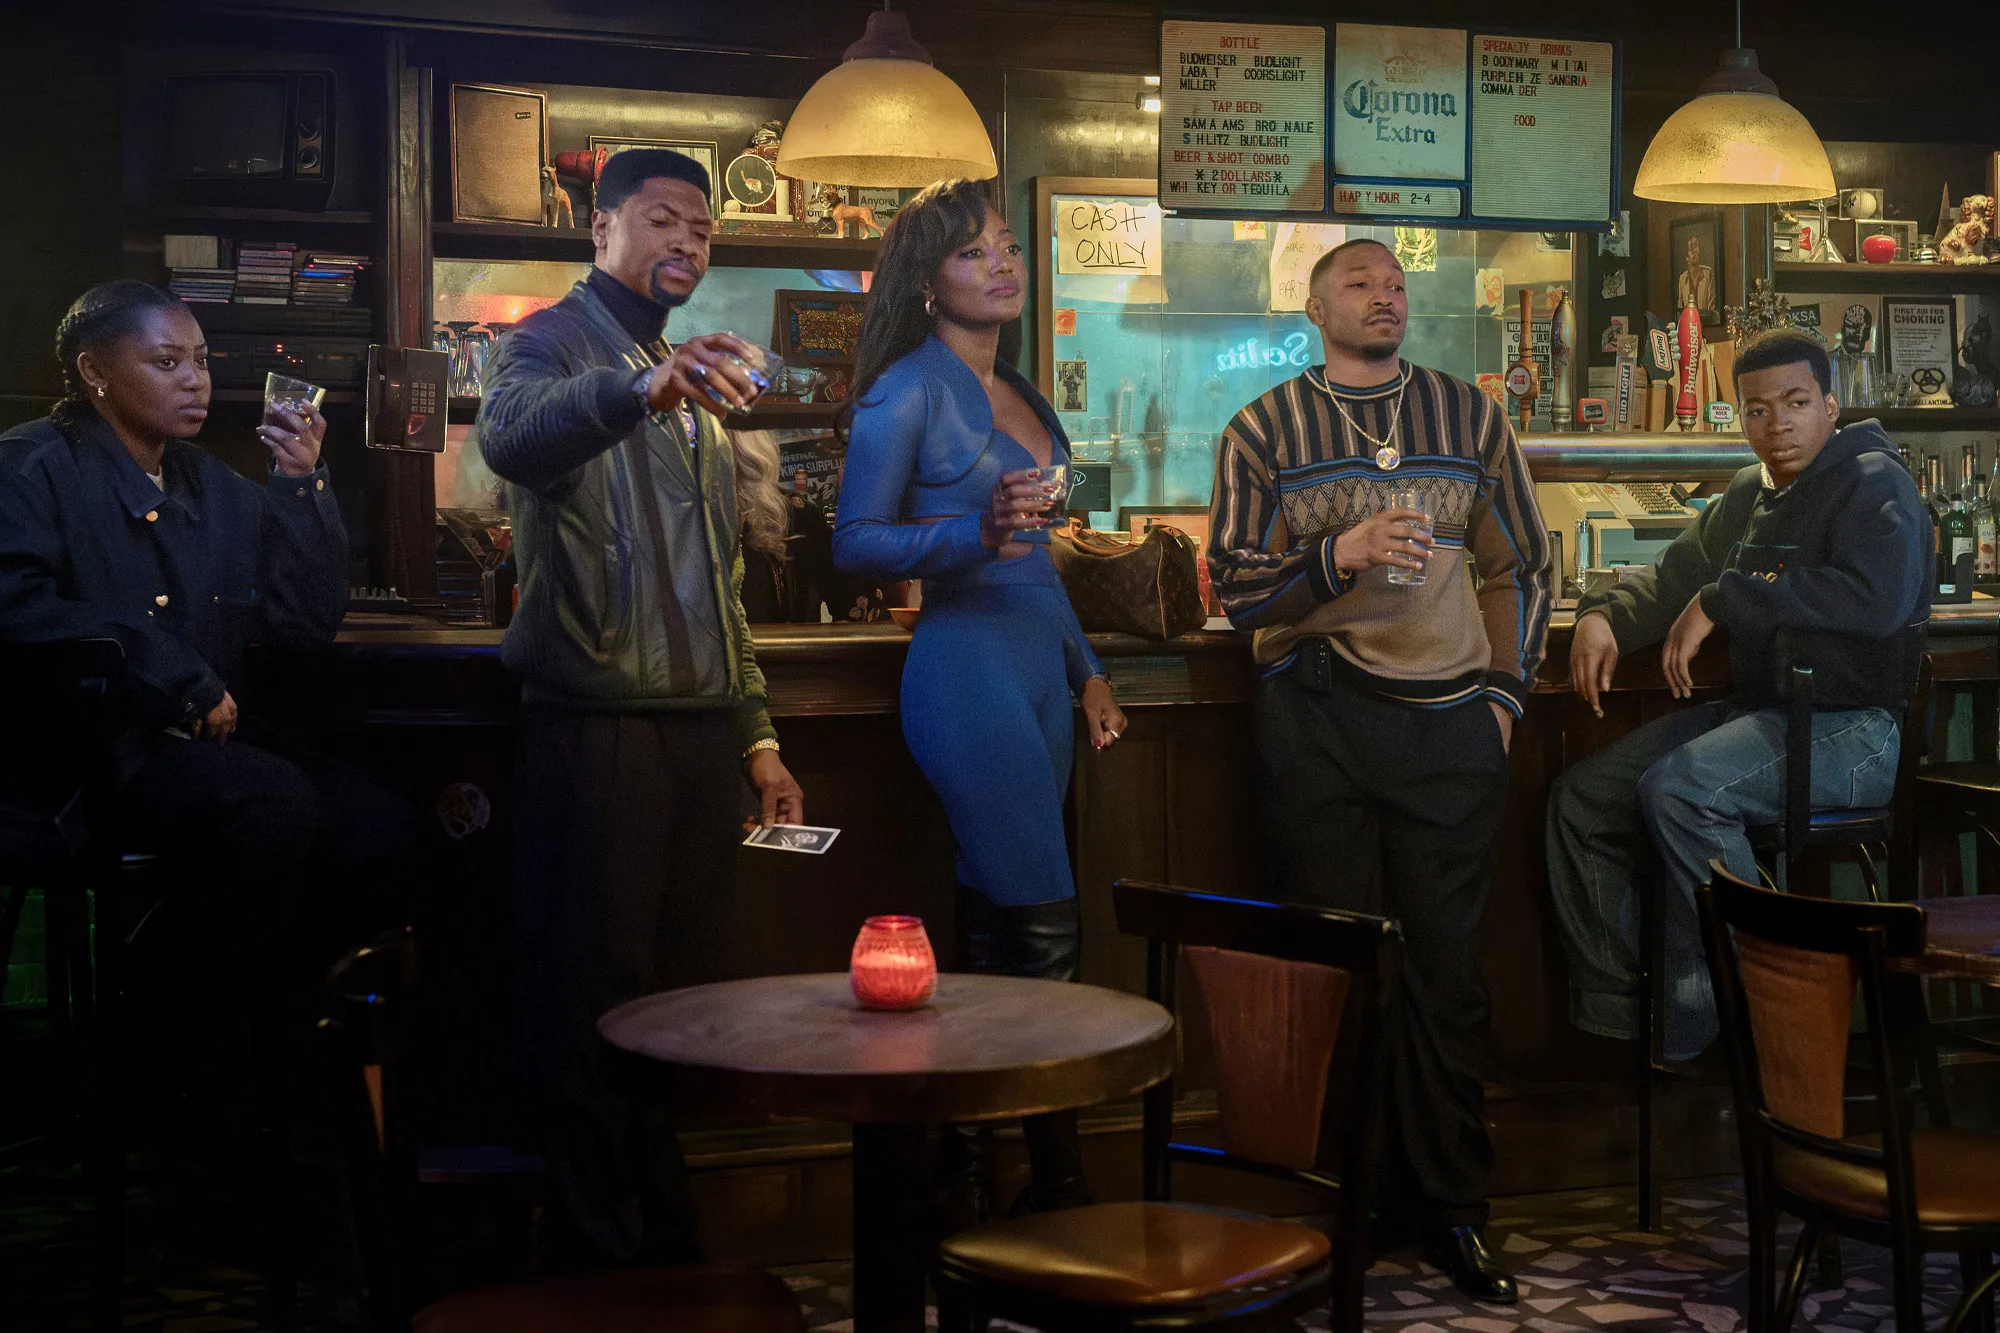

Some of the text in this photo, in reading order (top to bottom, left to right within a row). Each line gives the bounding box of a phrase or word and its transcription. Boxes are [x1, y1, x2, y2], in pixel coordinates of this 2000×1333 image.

[1219, 36, 1261, 49] BOTTLE
[1482, 40, 1572, 56] SPECIALTY DRINKS
[1179, 52, 1302, 69] BUDWEISER BUDLIGHT
[1244, 69, 1306, 82] COORSLIGHT
[1548, 74, 1587, 87] SANGRIA
[1179, 78, 1216, 91] MILLER
[1212, 100, 1263, 113] TAP BEER
[1343, 79, 1458, 124] Corona
[1514, 115, 1536, 126] FOOD
[1375, 116, 1436, 144] Extra
[1240, 134, 1290, 148] BUDLIGHT
[1174, 150, 1200, 162] BEER
[1253, 153, 1290, 165] COMBO
[1222, 183, 1236, 194] OR
[1242, 183, 1290, 196] TEQUILA
[1410, 193, 1431, 205] 2-4
[1071, 206, 1146, 232] CASH
[1076, 239, 1146, 265] ONLY
[1279, 279, 1310, 300] BART
[1893, 315, 1946, 325] CHOKING
[1684, 321, 1699, 395] Budweiser
[1619, 366, 1630, 423] BUD LIGHT
